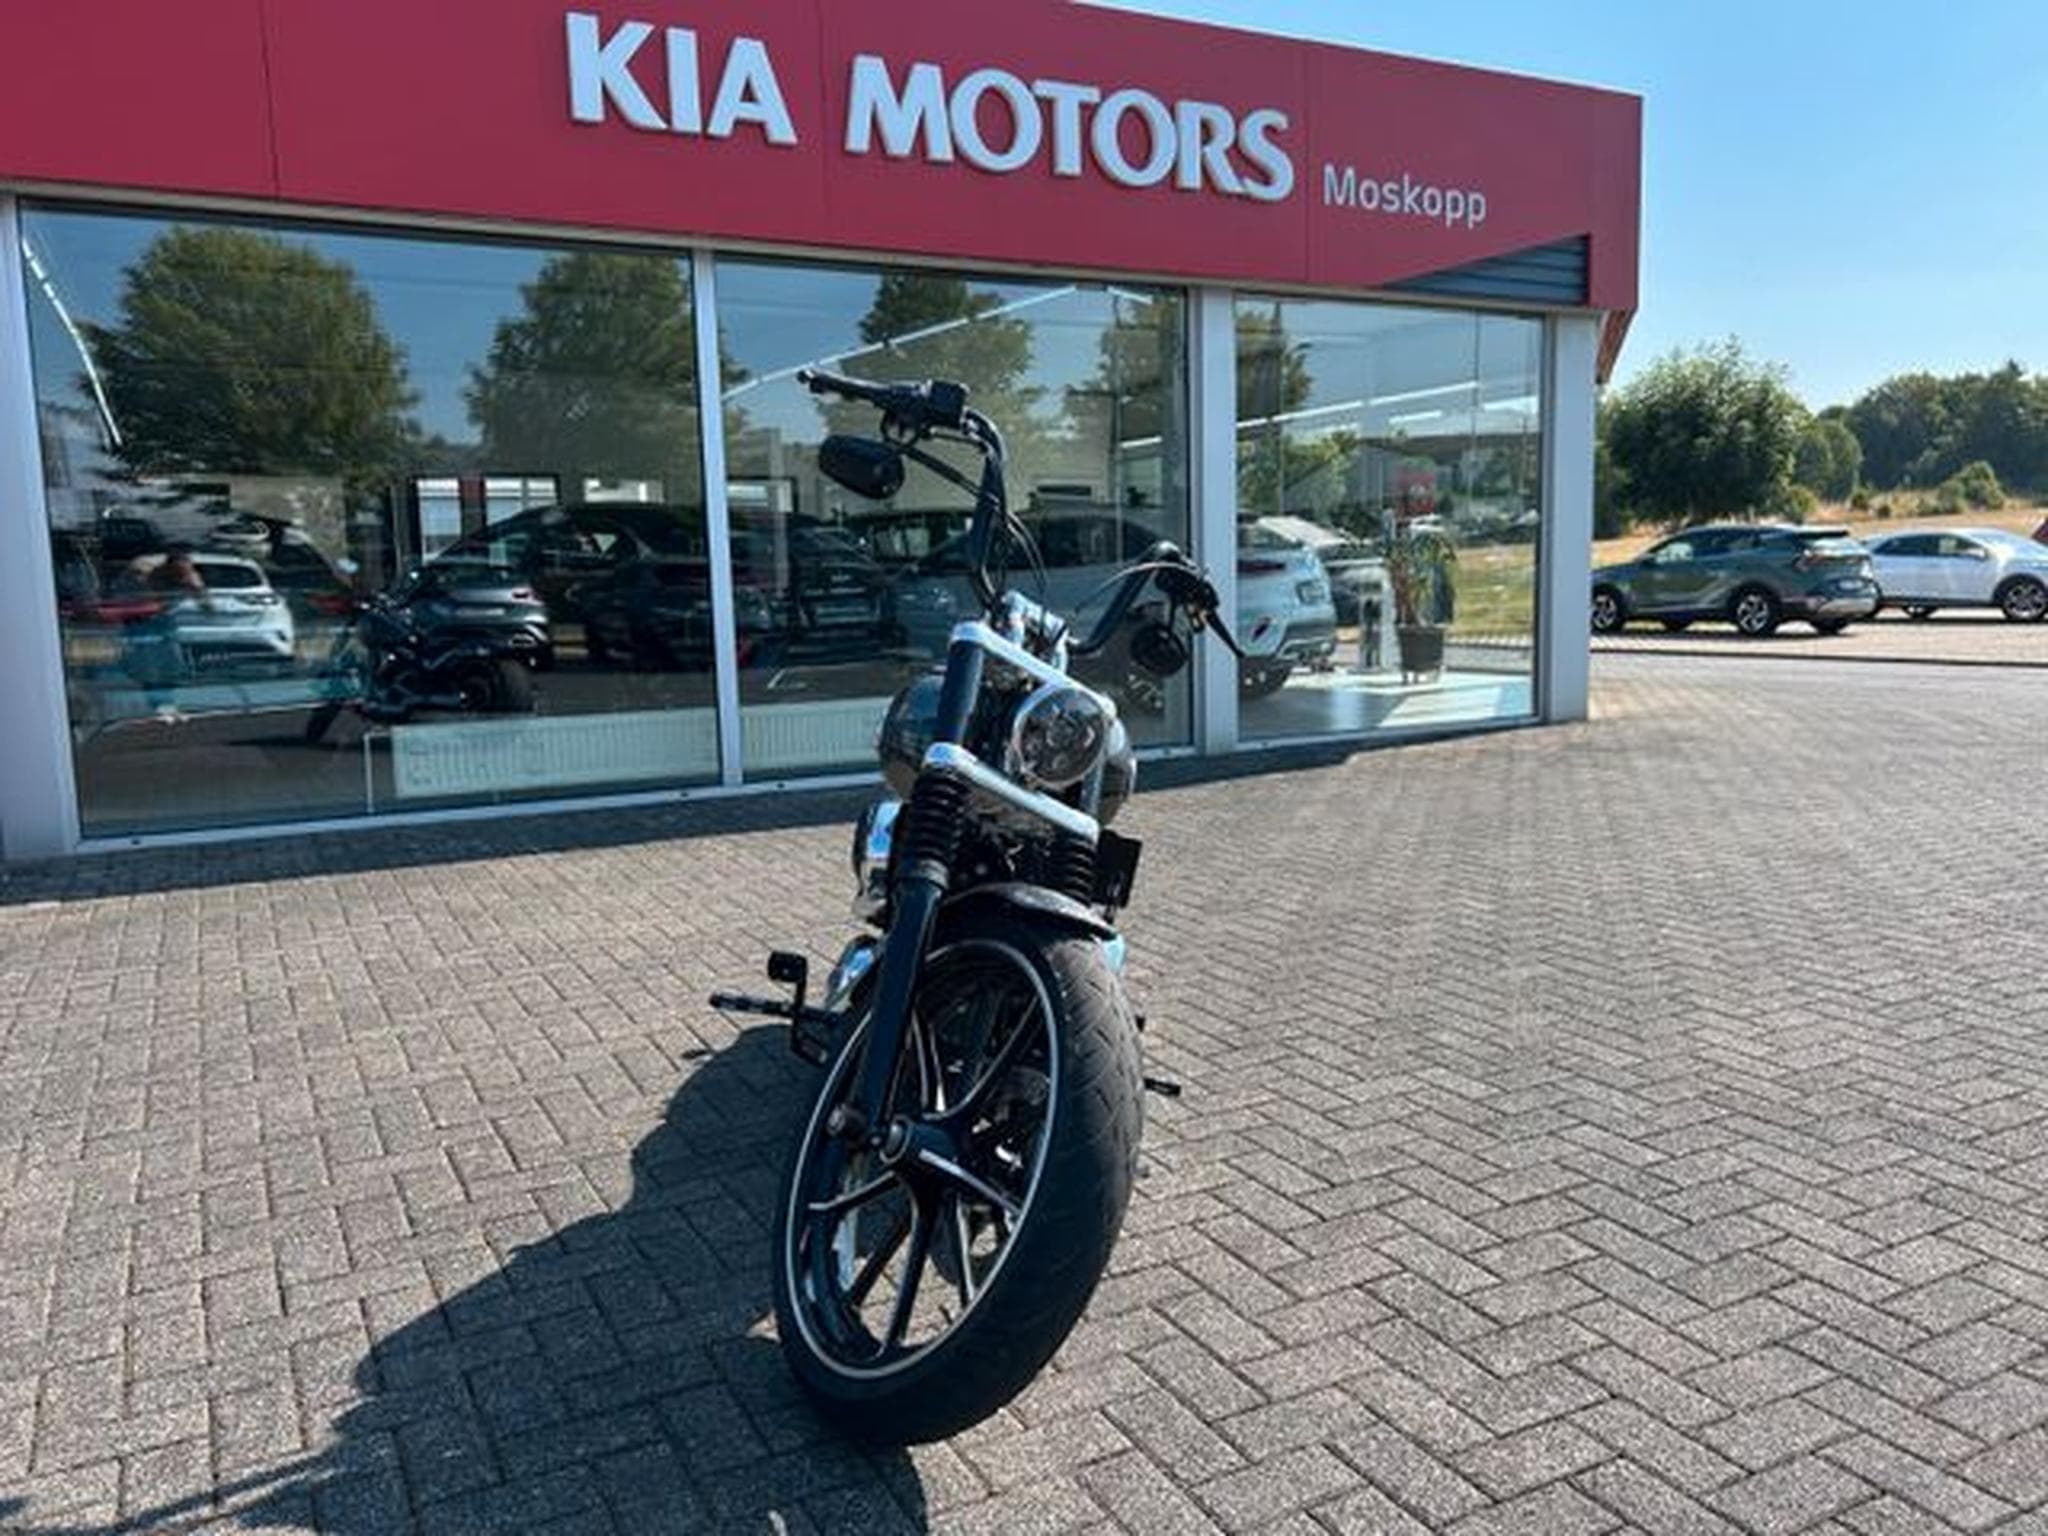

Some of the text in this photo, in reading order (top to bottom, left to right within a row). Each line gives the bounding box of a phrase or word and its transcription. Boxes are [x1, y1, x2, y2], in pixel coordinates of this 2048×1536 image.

[565, 11, 1295, 203] KIA MOTORS
[1323, 163, 1487, 229] Moskopp
